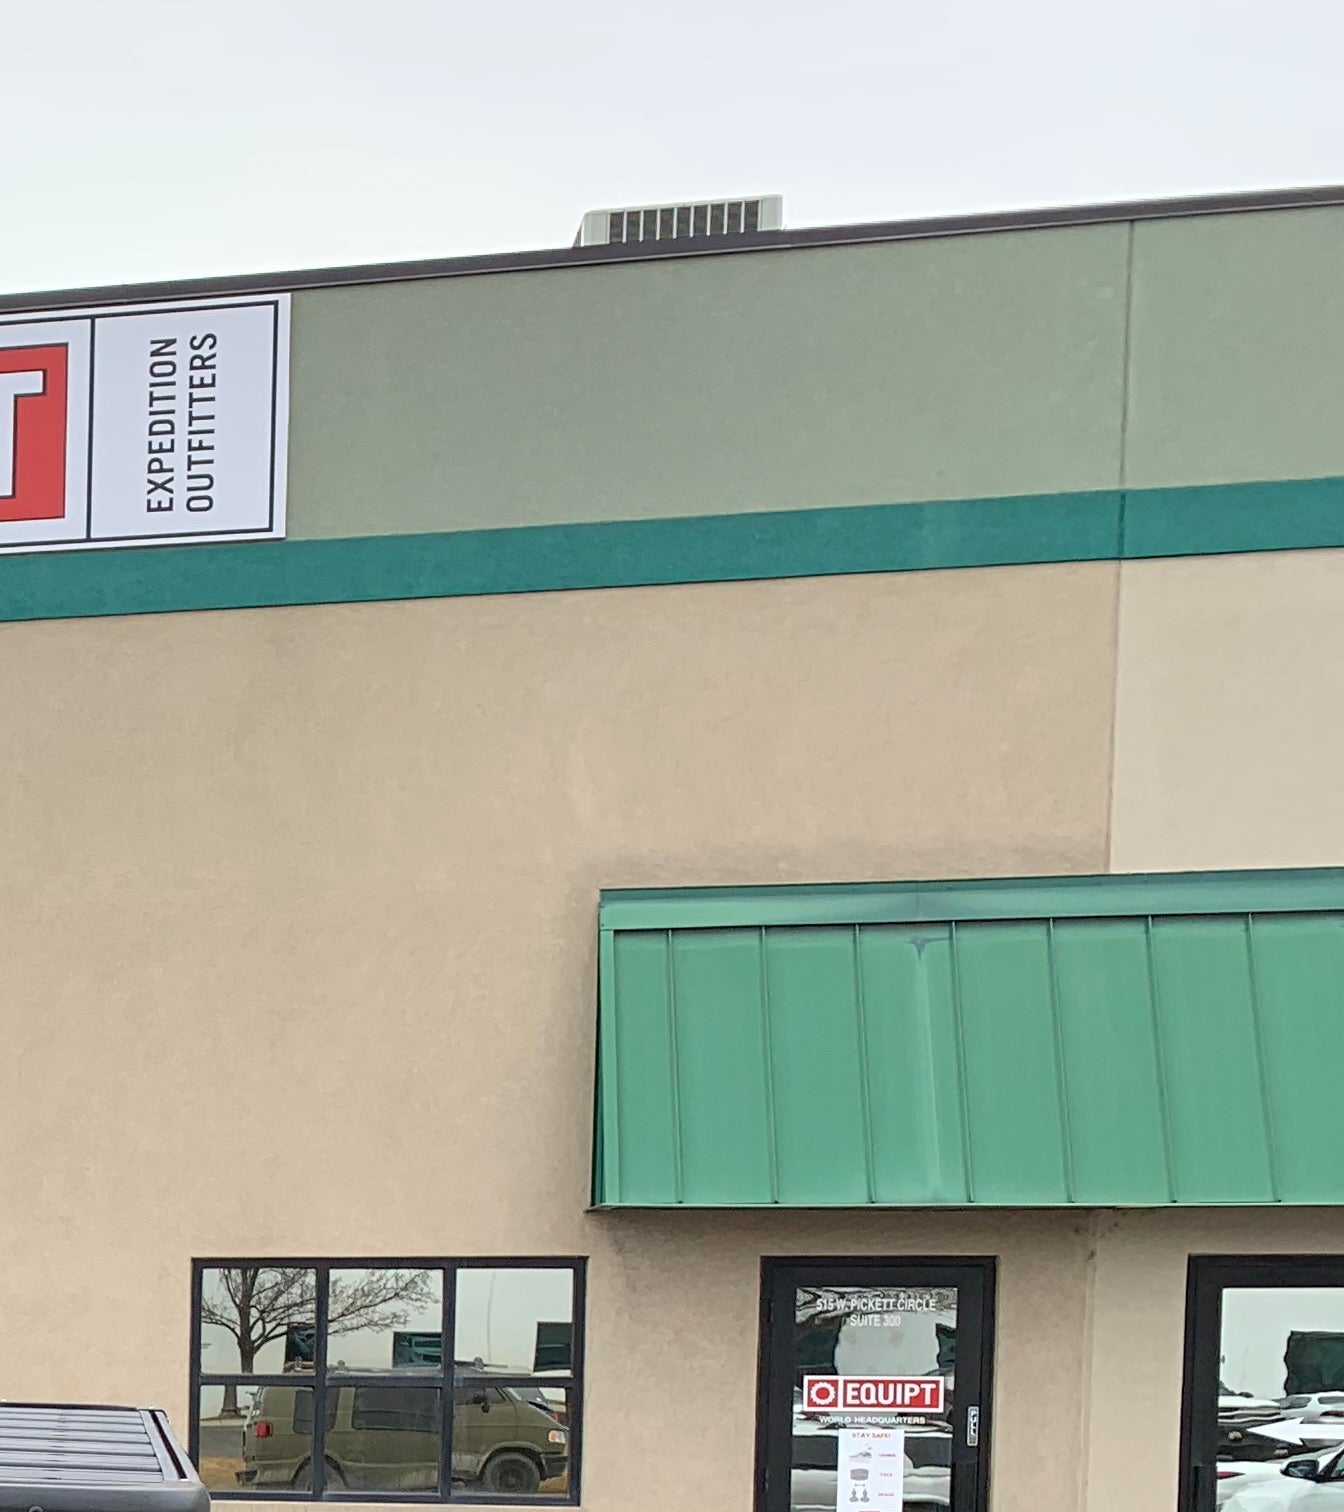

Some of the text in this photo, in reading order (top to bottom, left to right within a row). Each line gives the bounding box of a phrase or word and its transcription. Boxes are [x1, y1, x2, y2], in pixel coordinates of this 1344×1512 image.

[145, 336, 178, 514] EXPEDITION
[186, 331, 218, 513] OUTFITTERS
[816, 1299, 836, 1311] 515
[850, 1299, 897, 1311] PICKETT
[897, 1298, 936, 1311] CIRCLE
[850, 1314, 901, 1327] SUITE 300
[846, 1382, 937, 1406] EQUIPT
[819, 1416, 926, 1425] WORLD HEADQUARTERS
